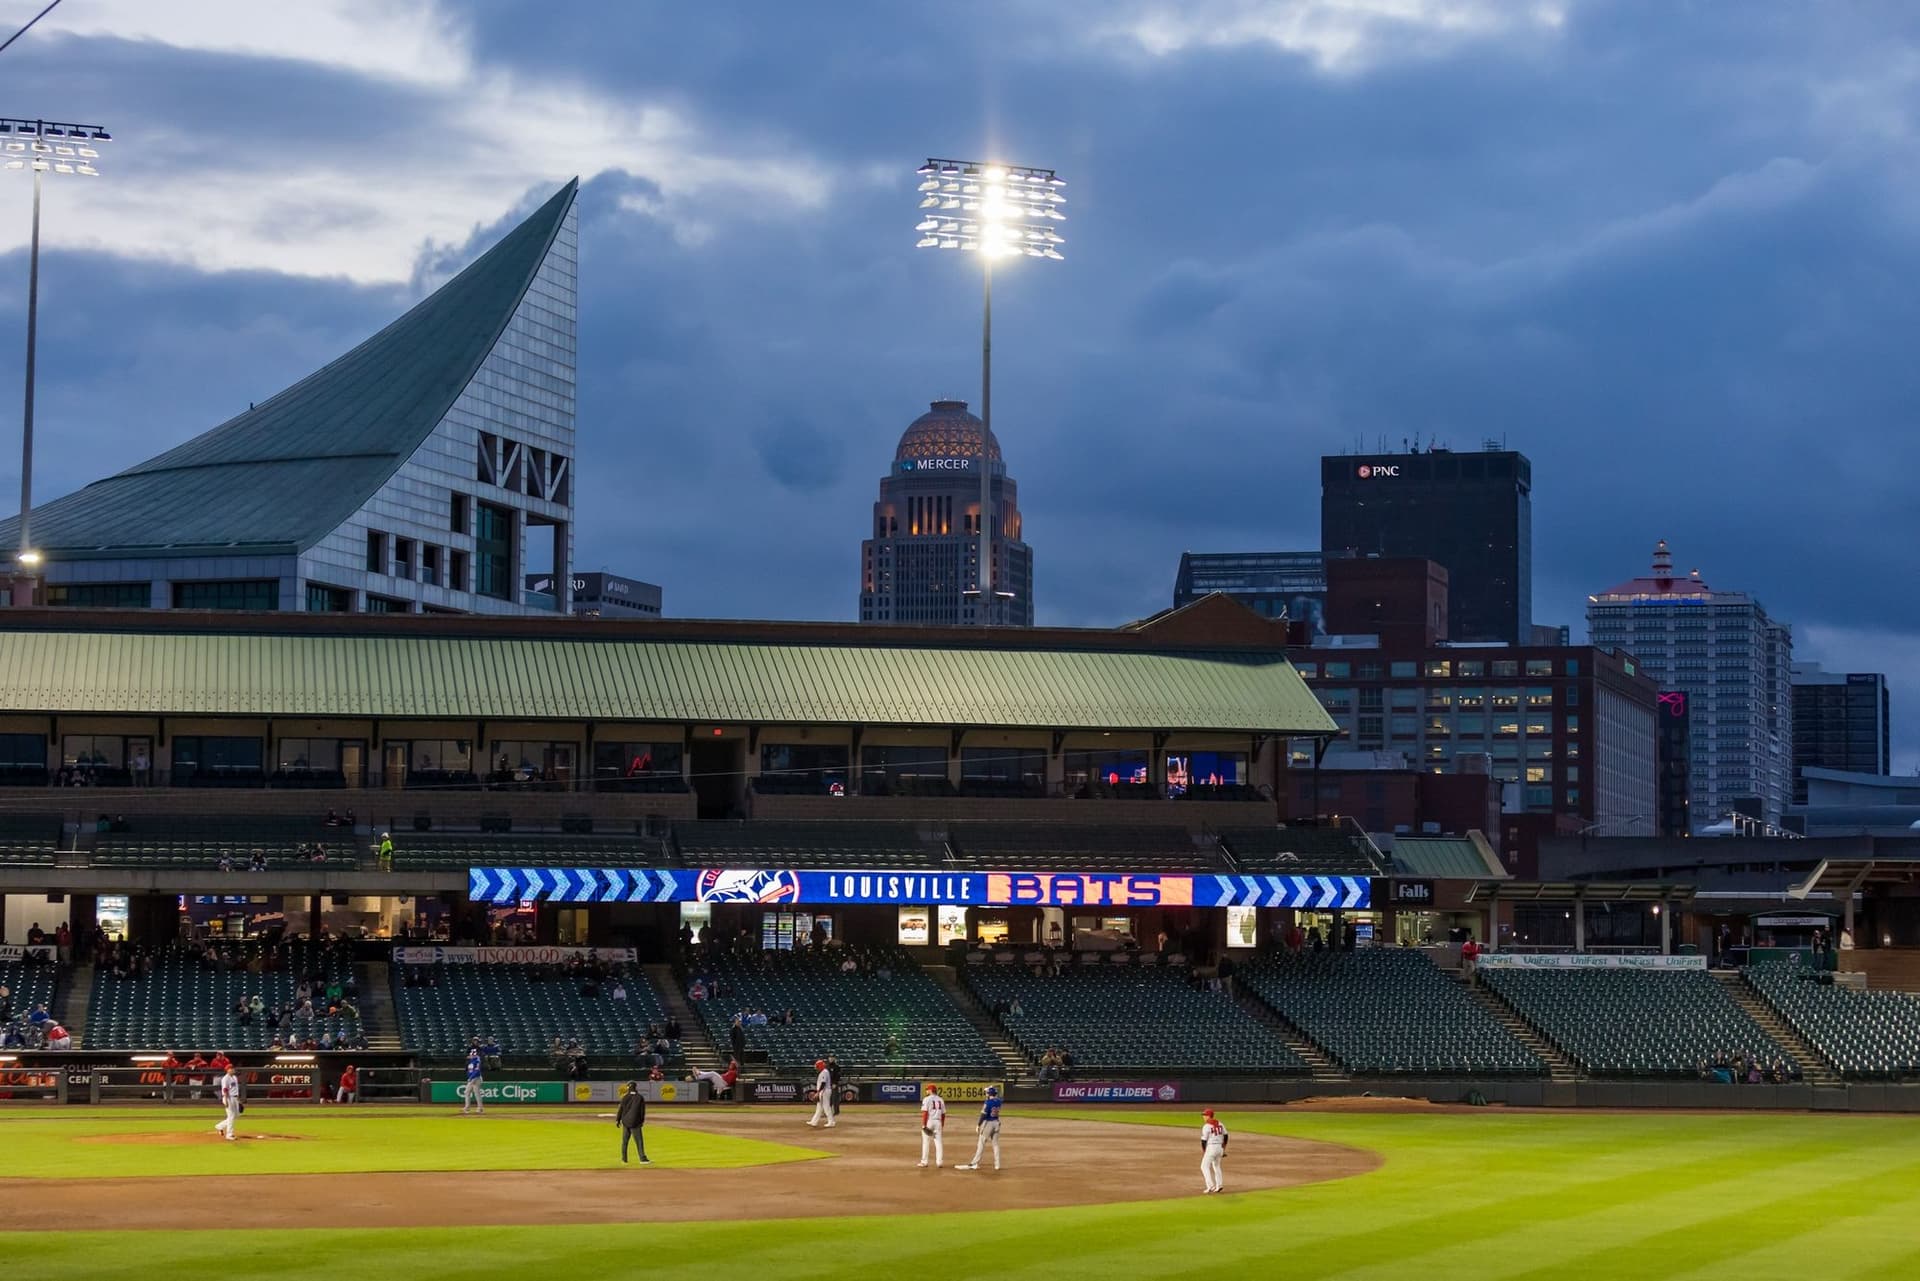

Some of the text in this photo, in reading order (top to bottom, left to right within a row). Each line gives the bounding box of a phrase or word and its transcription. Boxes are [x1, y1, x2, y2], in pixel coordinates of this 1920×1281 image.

[917, 459, 969, 470] MERCER
[1373, 465, 1400, 477] PNC
[829, 875, 1161, 905] LOUISVILLE BATS
[1399, 884, 1429, 898] Falls
[1523, 956, 1561, 966] UniFirst
[1571, 957, 1608, 966] UniFirst
[1618, 957, 1656, 966] UniFirst
[1665, 957, 1703, 966] UniFirst
[456, 1085, 537, 1101] Geat Clips
[755, 1084, 771, 1093] JACK
[881, 1085, 916, 1093] GEICO
[1059, 1087, 1086, 1097] LONG
[1088, 1087, 1111, 1097] LIVE
[1112, 1087, 1154, 1097] SLIDERS
